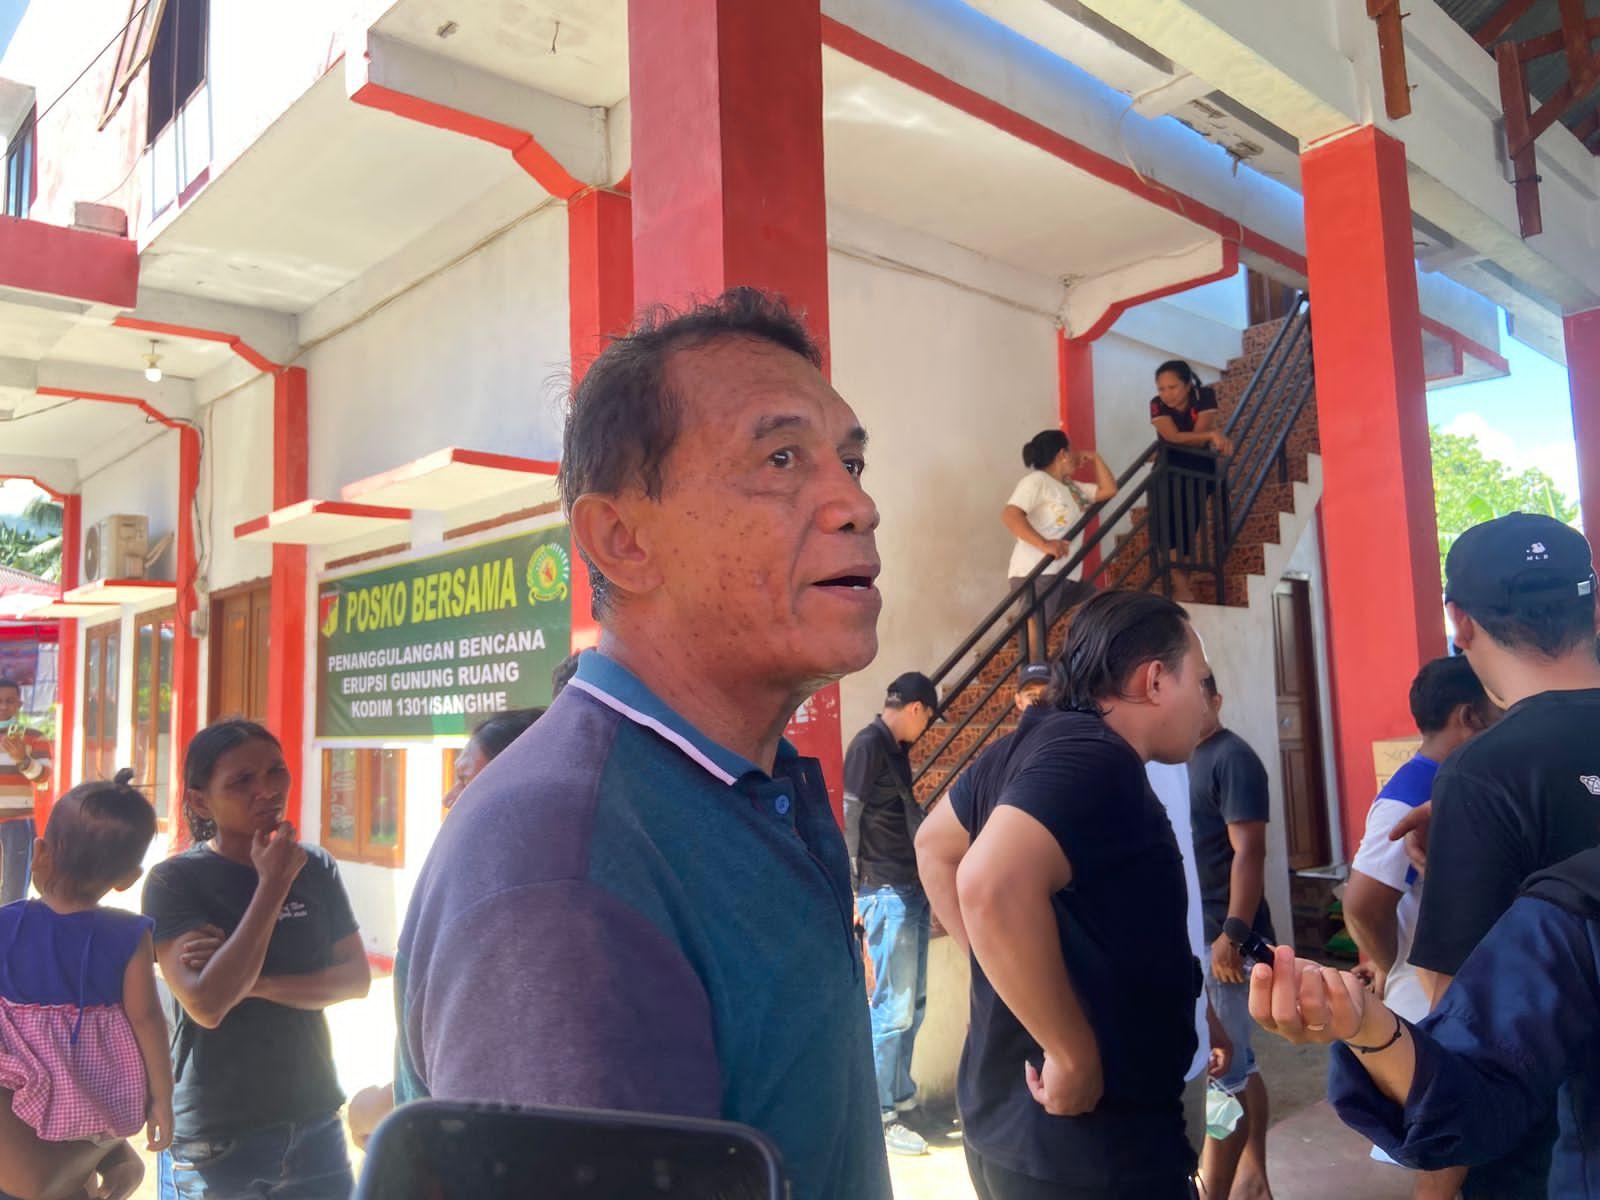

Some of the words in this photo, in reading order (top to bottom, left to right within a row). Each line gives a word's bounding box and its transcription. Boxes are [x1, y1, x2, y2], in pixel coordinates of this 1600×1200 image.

[346, 582, 407, 633] POSKO
[412, 558, 517, 624] BERSAMA
[328, 640, 454, 672] PENANGGULANGAN
[459, 629, 545, 658] BENCANA
[342, 674, 387, 694] ERUPSI
[391, 668, 454, 690] GUNUNG
[458, 662, 519, 686] RUANG
[351, 697, 392, 718] KODIM
[396, 692, 507, 717] 1301/SANGIHE
